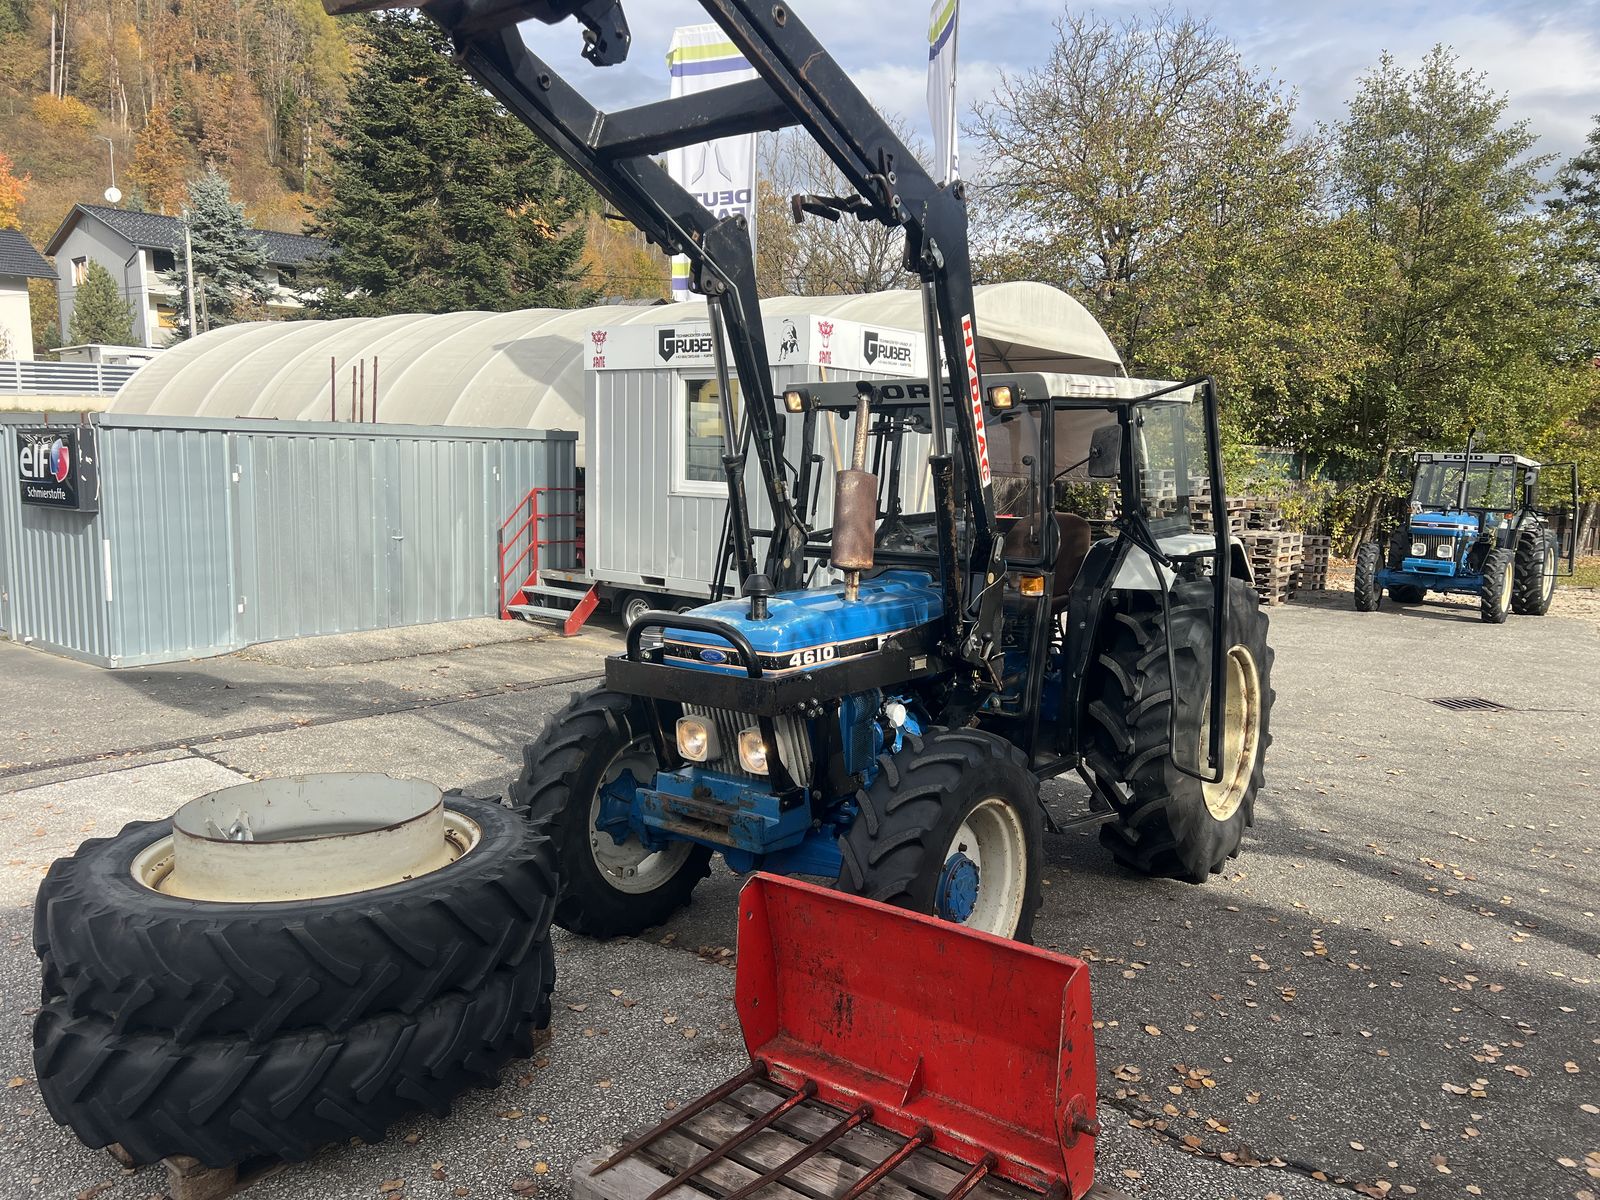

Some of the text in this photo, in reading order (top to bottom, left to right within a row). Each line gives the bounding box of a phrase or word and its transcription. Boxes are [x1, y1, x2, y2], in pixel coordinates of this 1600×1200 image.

[863, 331, 911, 366] GRUBER
[962, 319, 990, 482] HYDRAC
[20, 444, 49, 478] elf
[27, 486, 66, 500] Schmierstoffe
[790, 646, 834, 667] 4610
